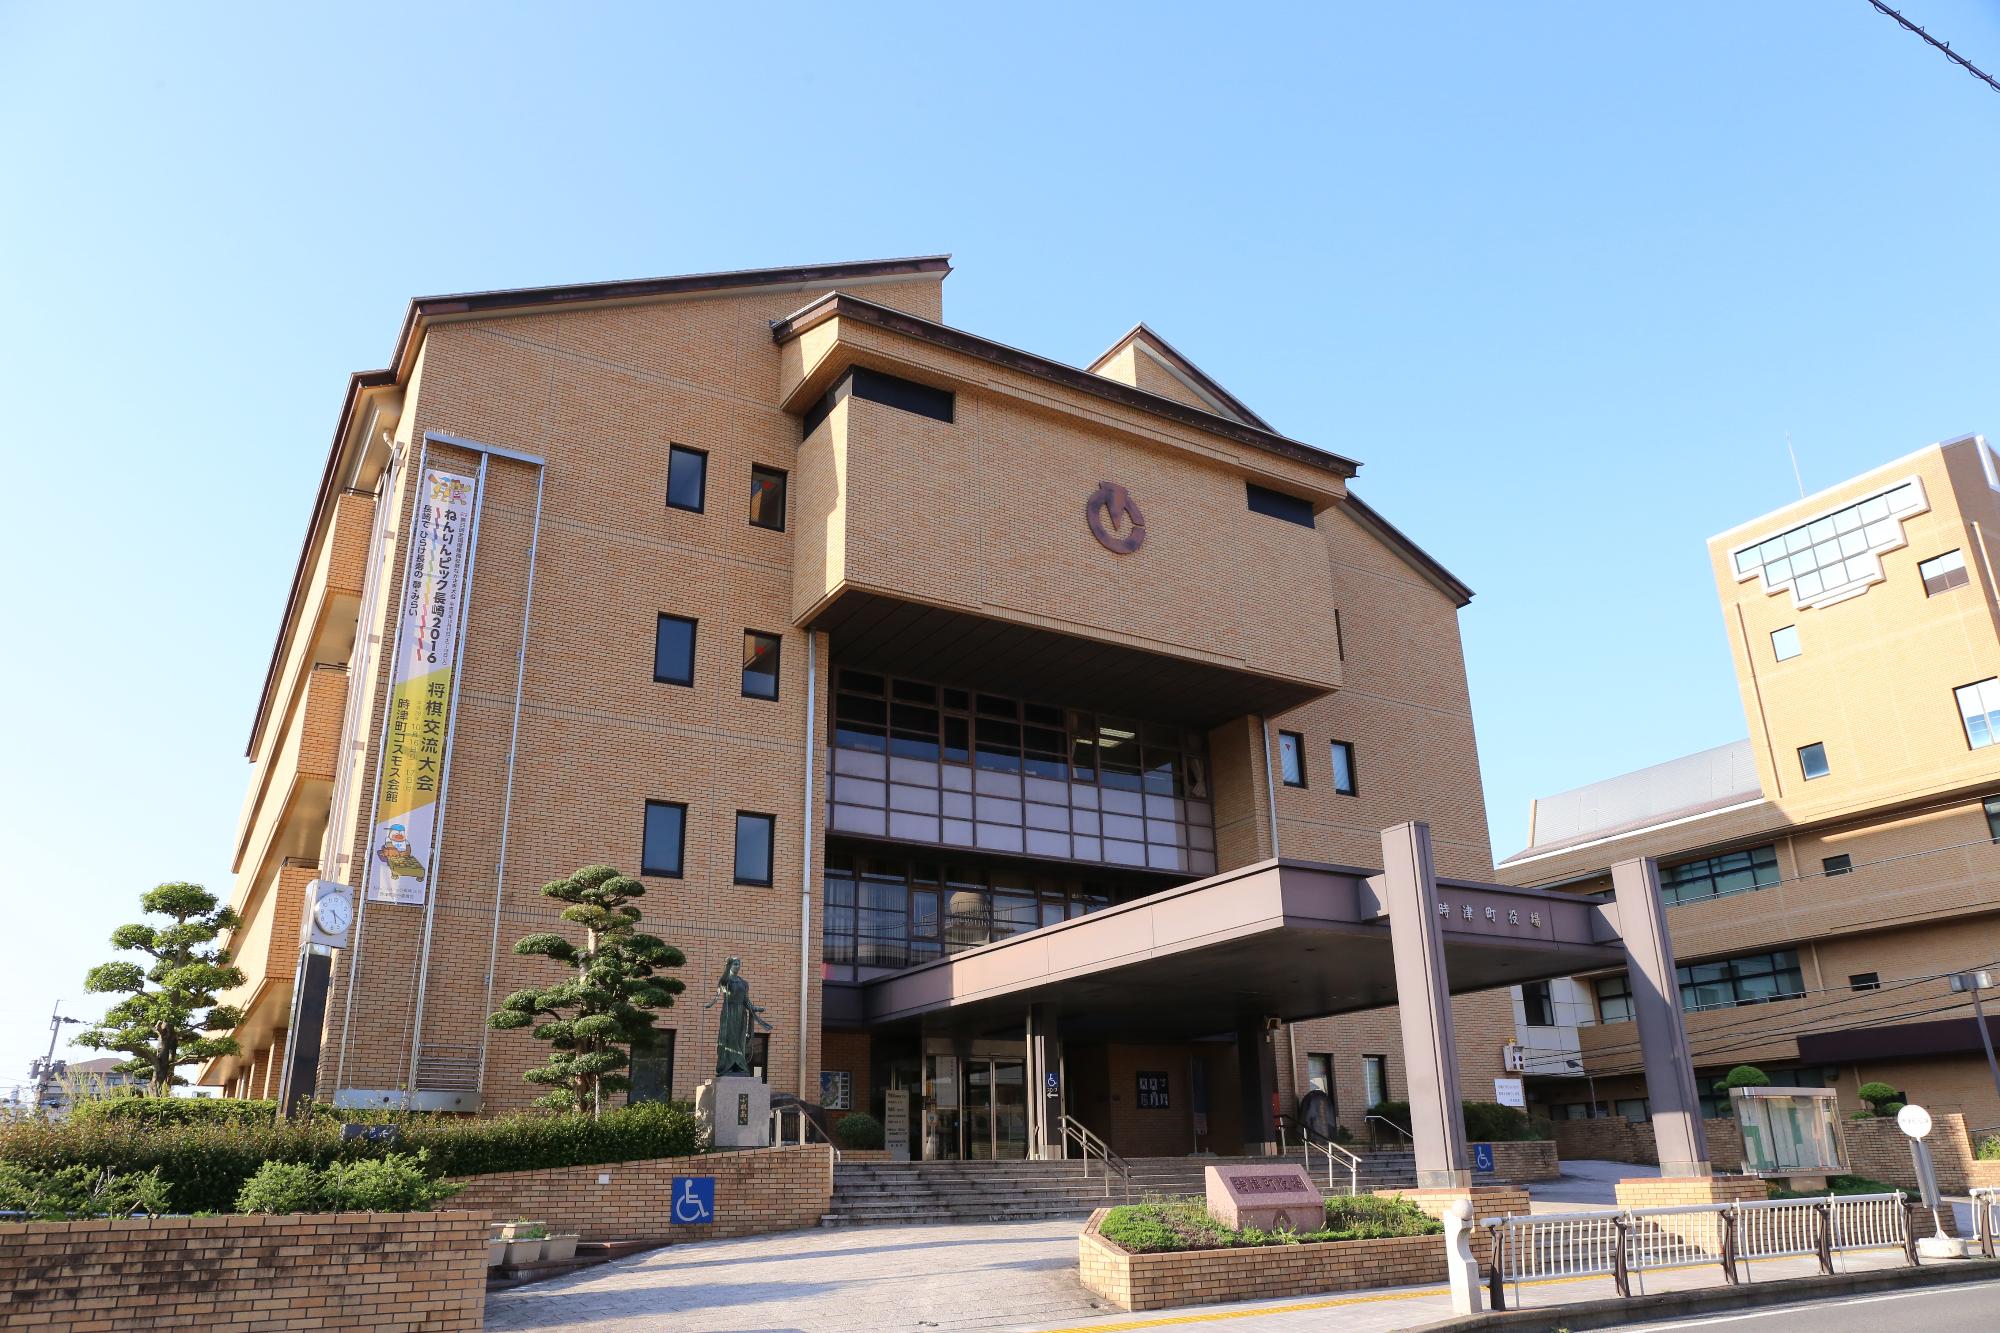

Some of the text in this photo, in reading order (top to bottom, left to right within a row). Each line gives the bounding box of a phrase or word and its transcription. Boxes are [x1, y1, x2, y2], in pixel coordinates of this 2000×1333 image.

[426, 509, 458, 665] ねんりんピック長崎2016
[385, 698, 411, 804] 時津町コスモス会館
[416, 681, 446, 792] 将棋交流大会
[1439, 902, 1542, 928] 時津町役場
